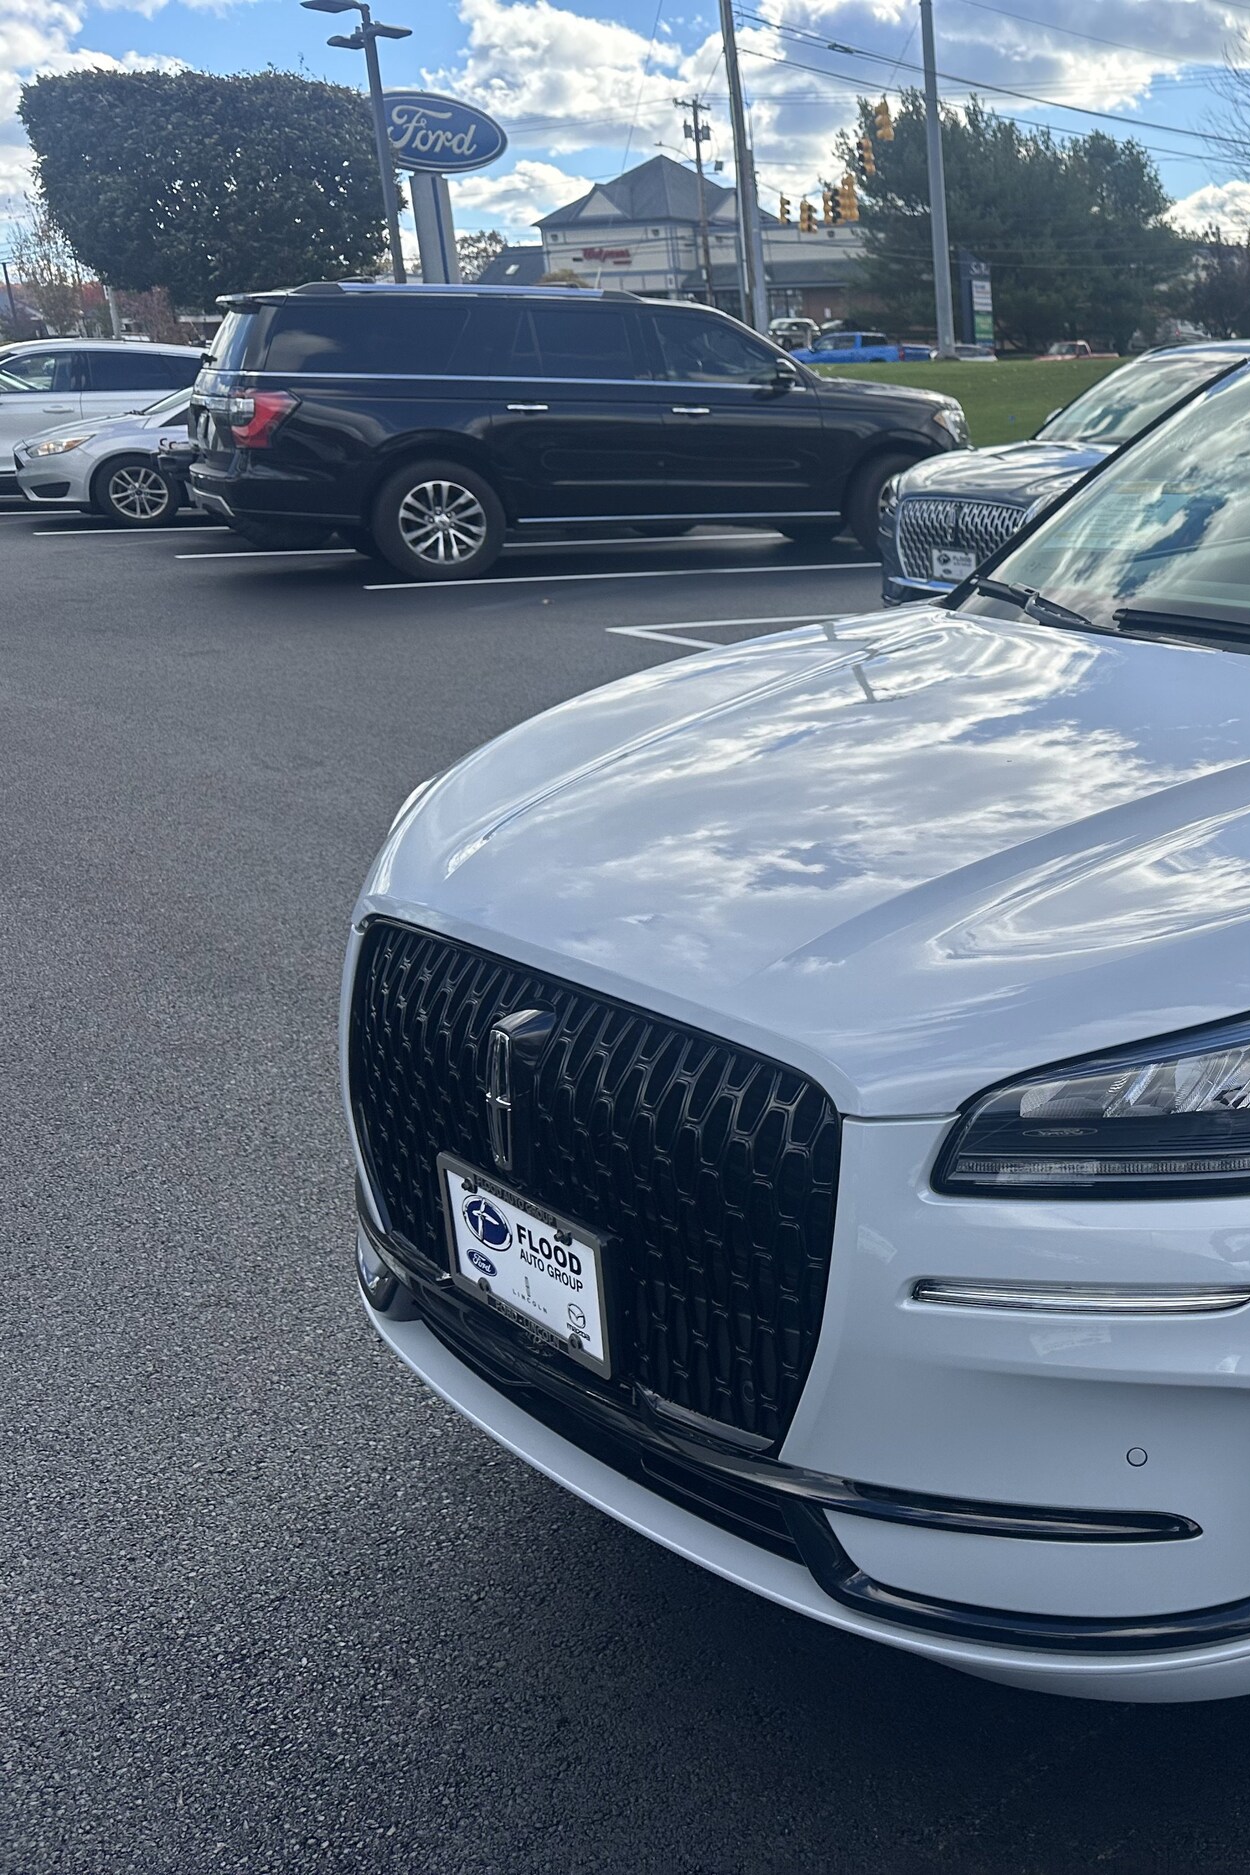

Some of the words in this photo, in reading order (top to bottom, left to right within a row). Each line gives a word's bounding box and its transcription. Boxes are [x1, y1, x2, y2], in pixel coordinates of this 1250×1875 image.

[387, 105, 477, 155] Ford
[516, 1223, 582, 1275] FLOOD
[520, 1248, 544, 1272] AUTO
[547, 1264, 583, 1292] GROUP
[512, 1288, 548, 1314] LINCOLN
